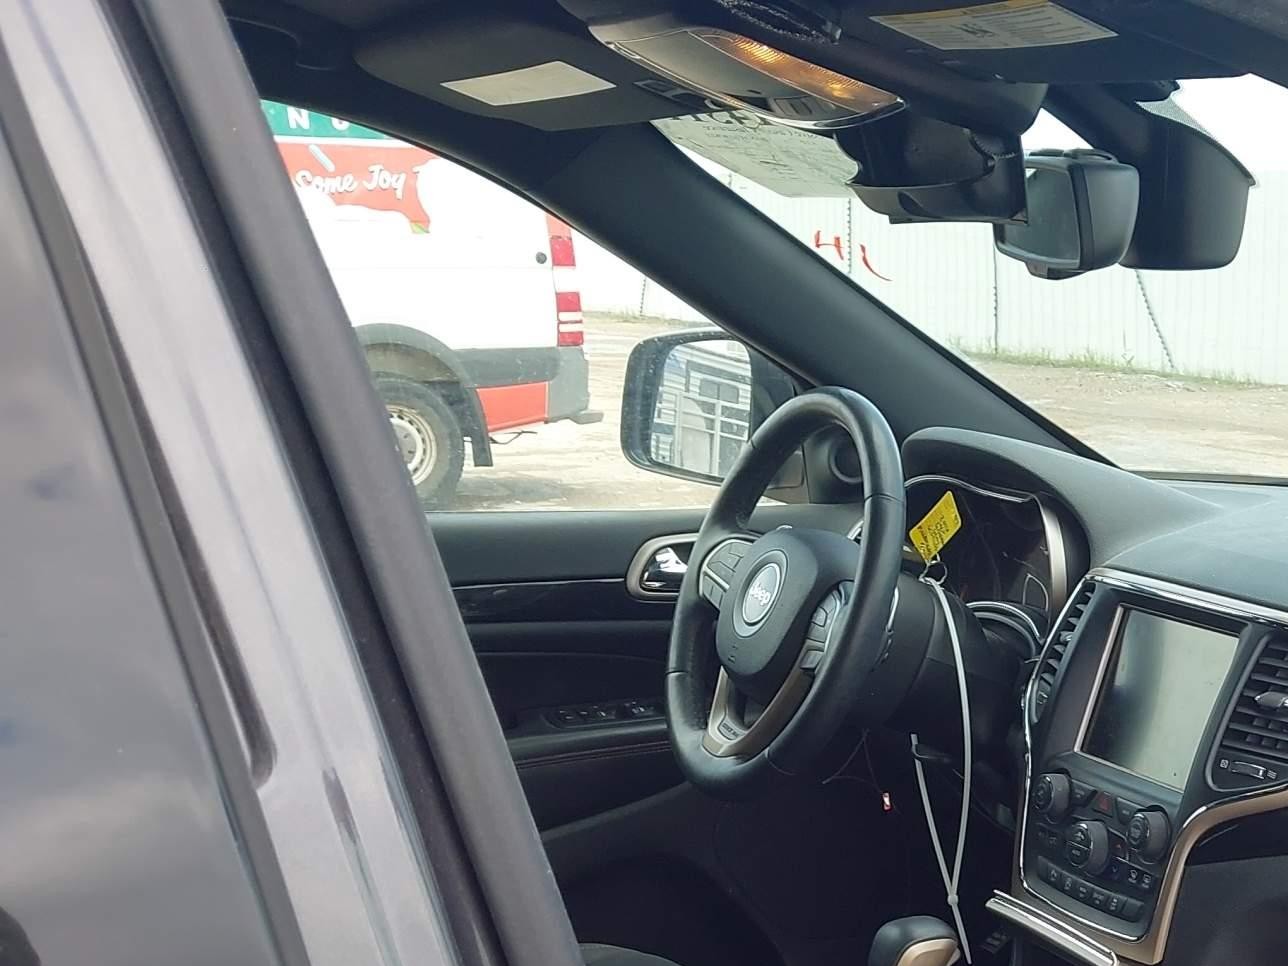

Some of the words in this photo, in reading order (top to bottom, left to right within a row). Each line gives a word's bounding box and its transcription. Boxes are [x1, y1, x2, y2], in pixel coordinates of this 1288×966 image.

[296, 169, 358, 195] Some
[363, 163, 407, 201] Joy
[749, 582, 772, 606] Jeep
